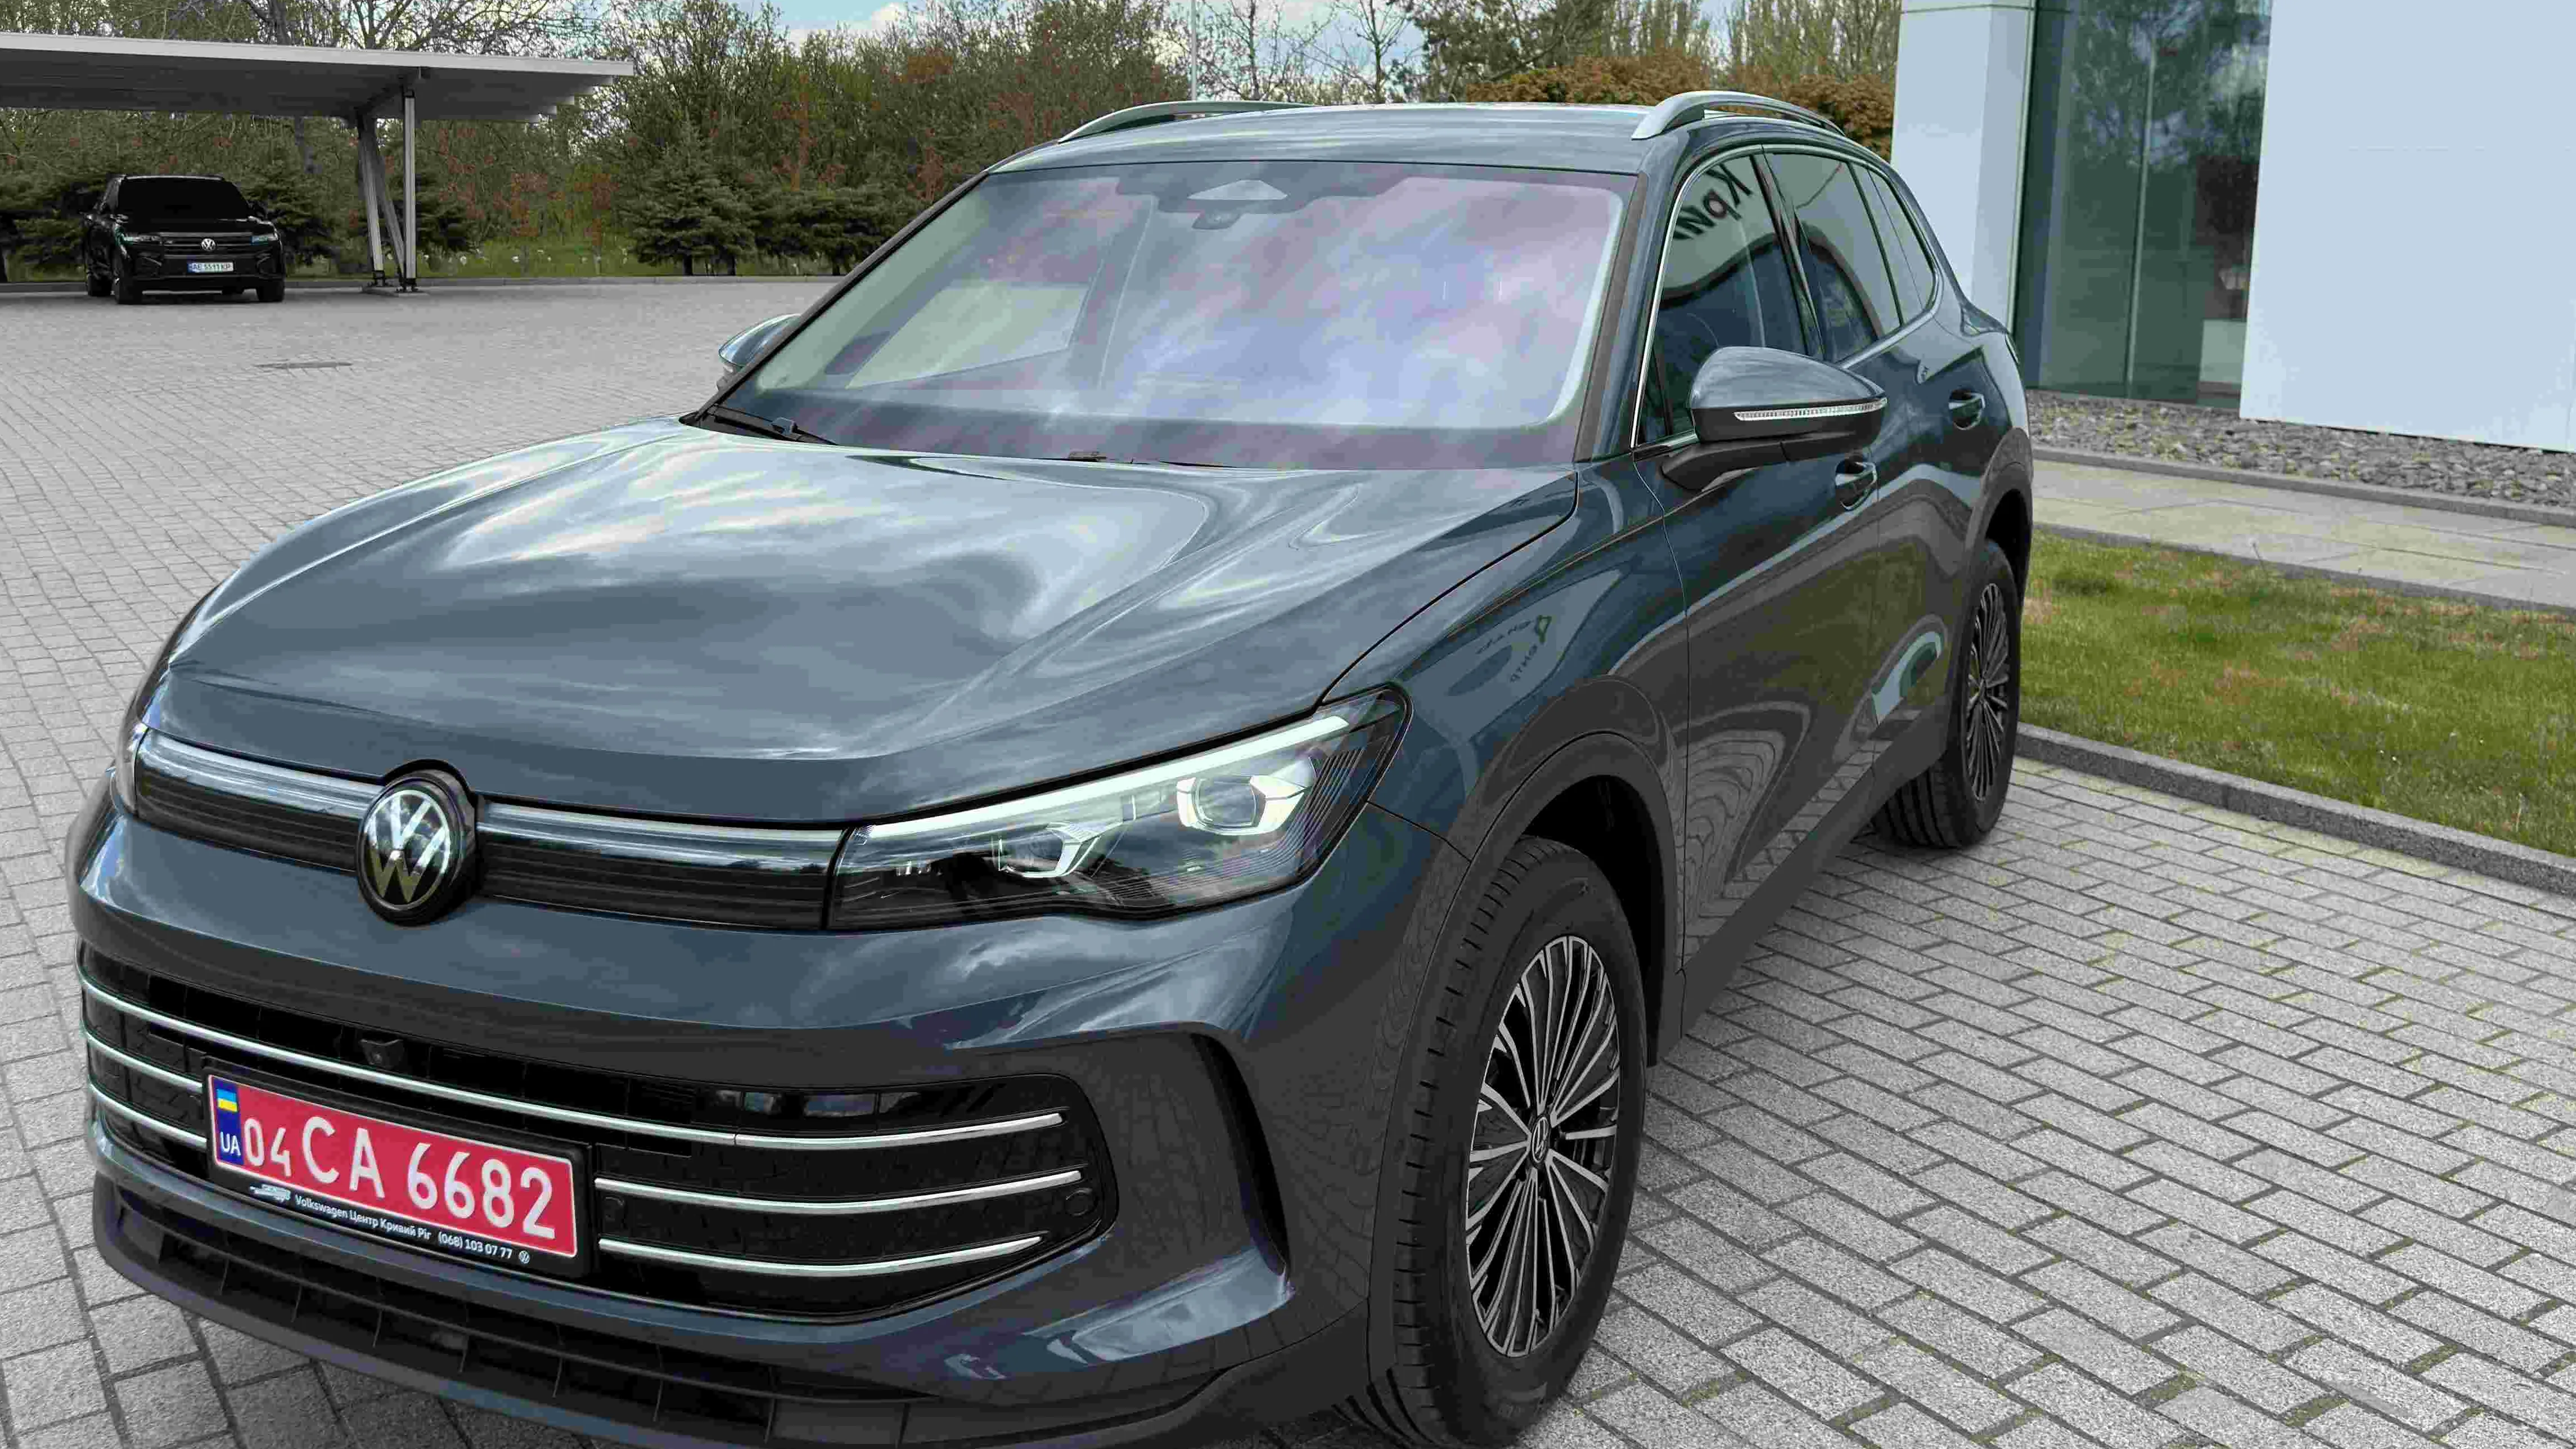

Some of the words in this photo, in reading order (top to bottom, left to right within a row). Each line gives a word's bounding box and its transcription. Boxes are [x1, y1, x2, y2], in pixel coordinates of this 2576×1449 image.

[364, 789, 451, 911] VW
[220, 1131, 242, 1156] UA
[294, 1194, 348, 1218] Volkswagen
[349, 1210, 378, 1228] Центр
[380, 1218, 416, 1237] Кривий
[437, 1231, 463, 1249] (068)
[465, 1238, 484, 1252] 103
[485, 1242, 498, 1255] 07
[499, 1246, 512, 1259] 77
[407, 1142, 556, 1240] 6682
